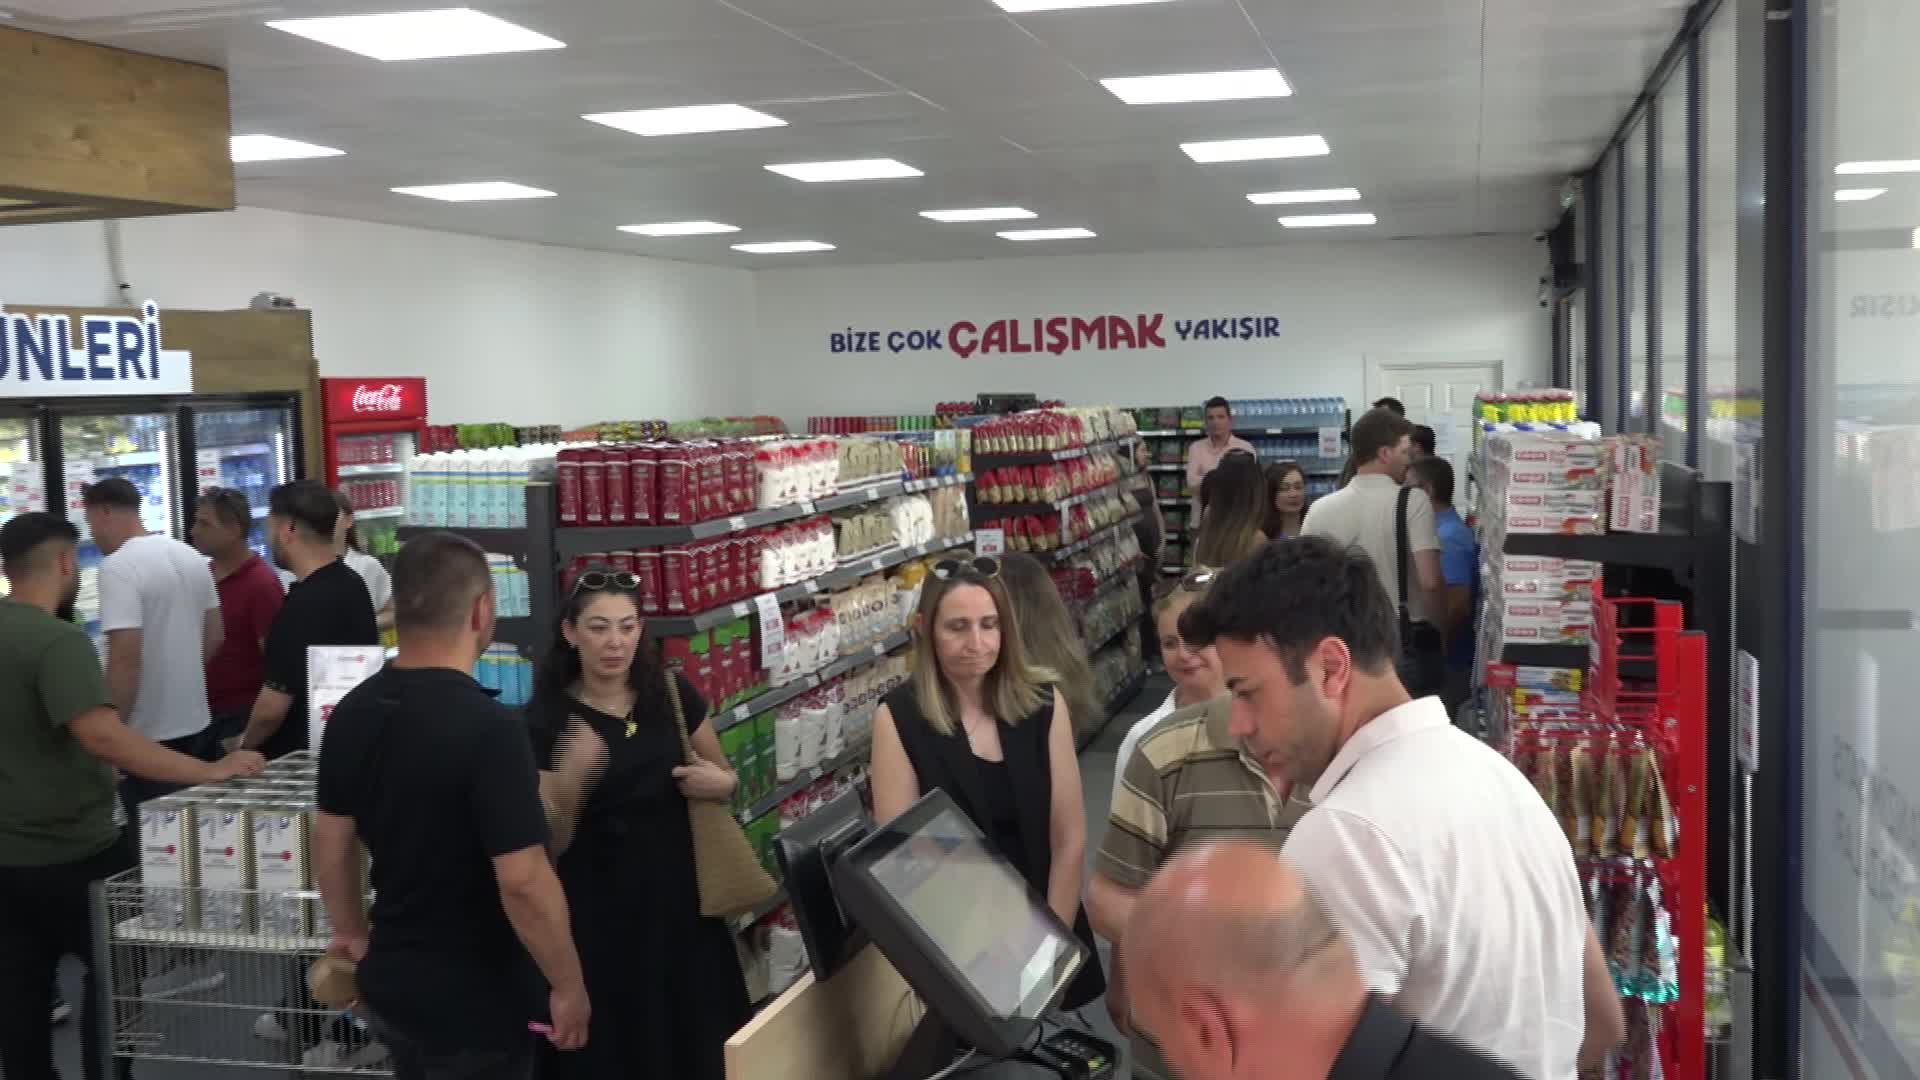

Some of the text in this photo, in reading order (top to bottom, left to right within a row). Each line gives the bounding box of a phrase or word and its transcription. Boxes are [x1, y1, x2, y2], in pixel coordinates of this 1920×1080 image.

[830, 313, 1281, 359] BİZE ÇOK ÇALIŞMAK YAKIŞIR
